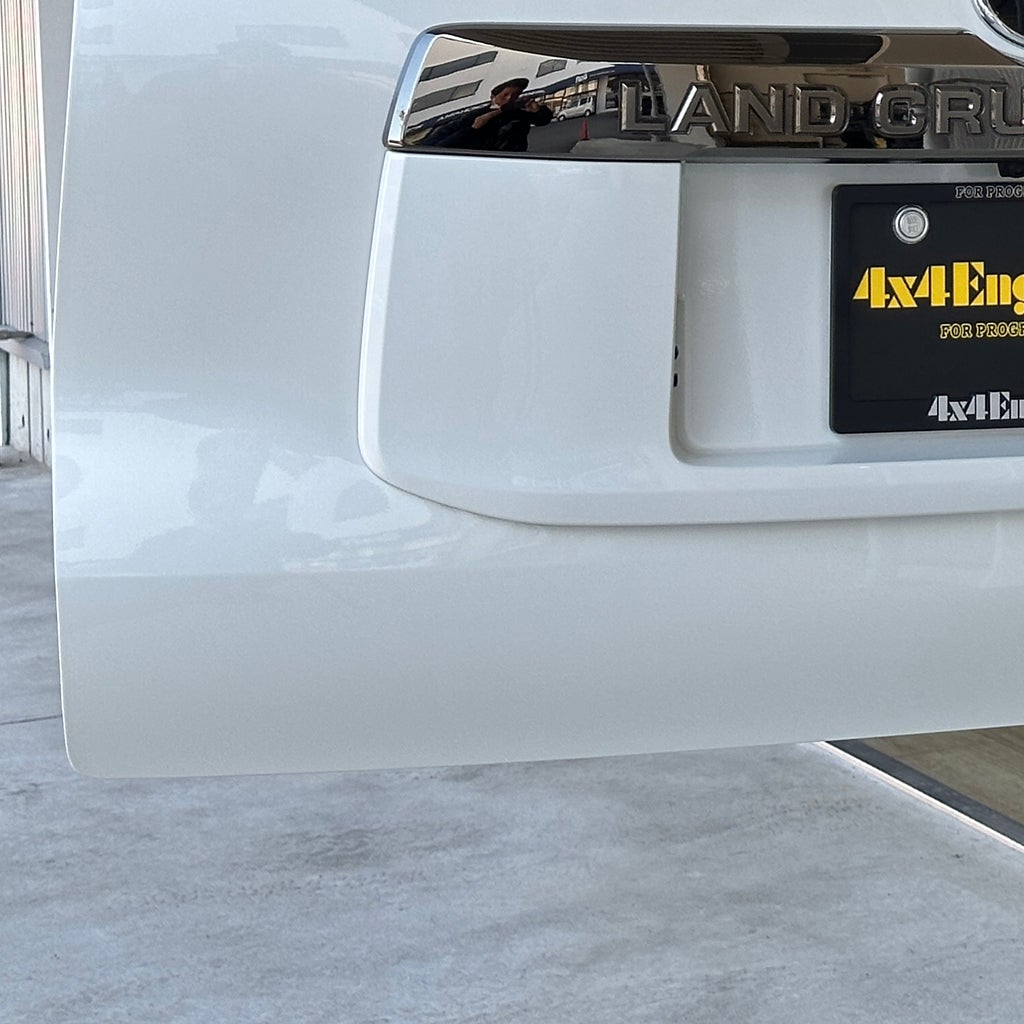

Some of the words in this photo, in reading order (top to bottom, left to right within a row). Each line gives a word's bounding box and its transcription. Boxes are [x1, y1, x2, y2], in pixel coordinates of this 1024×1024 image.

[618, 78, 850, 137] LAND
[955, 185, 983, 199] FOR
[940, 323, 973, 339] FOR
